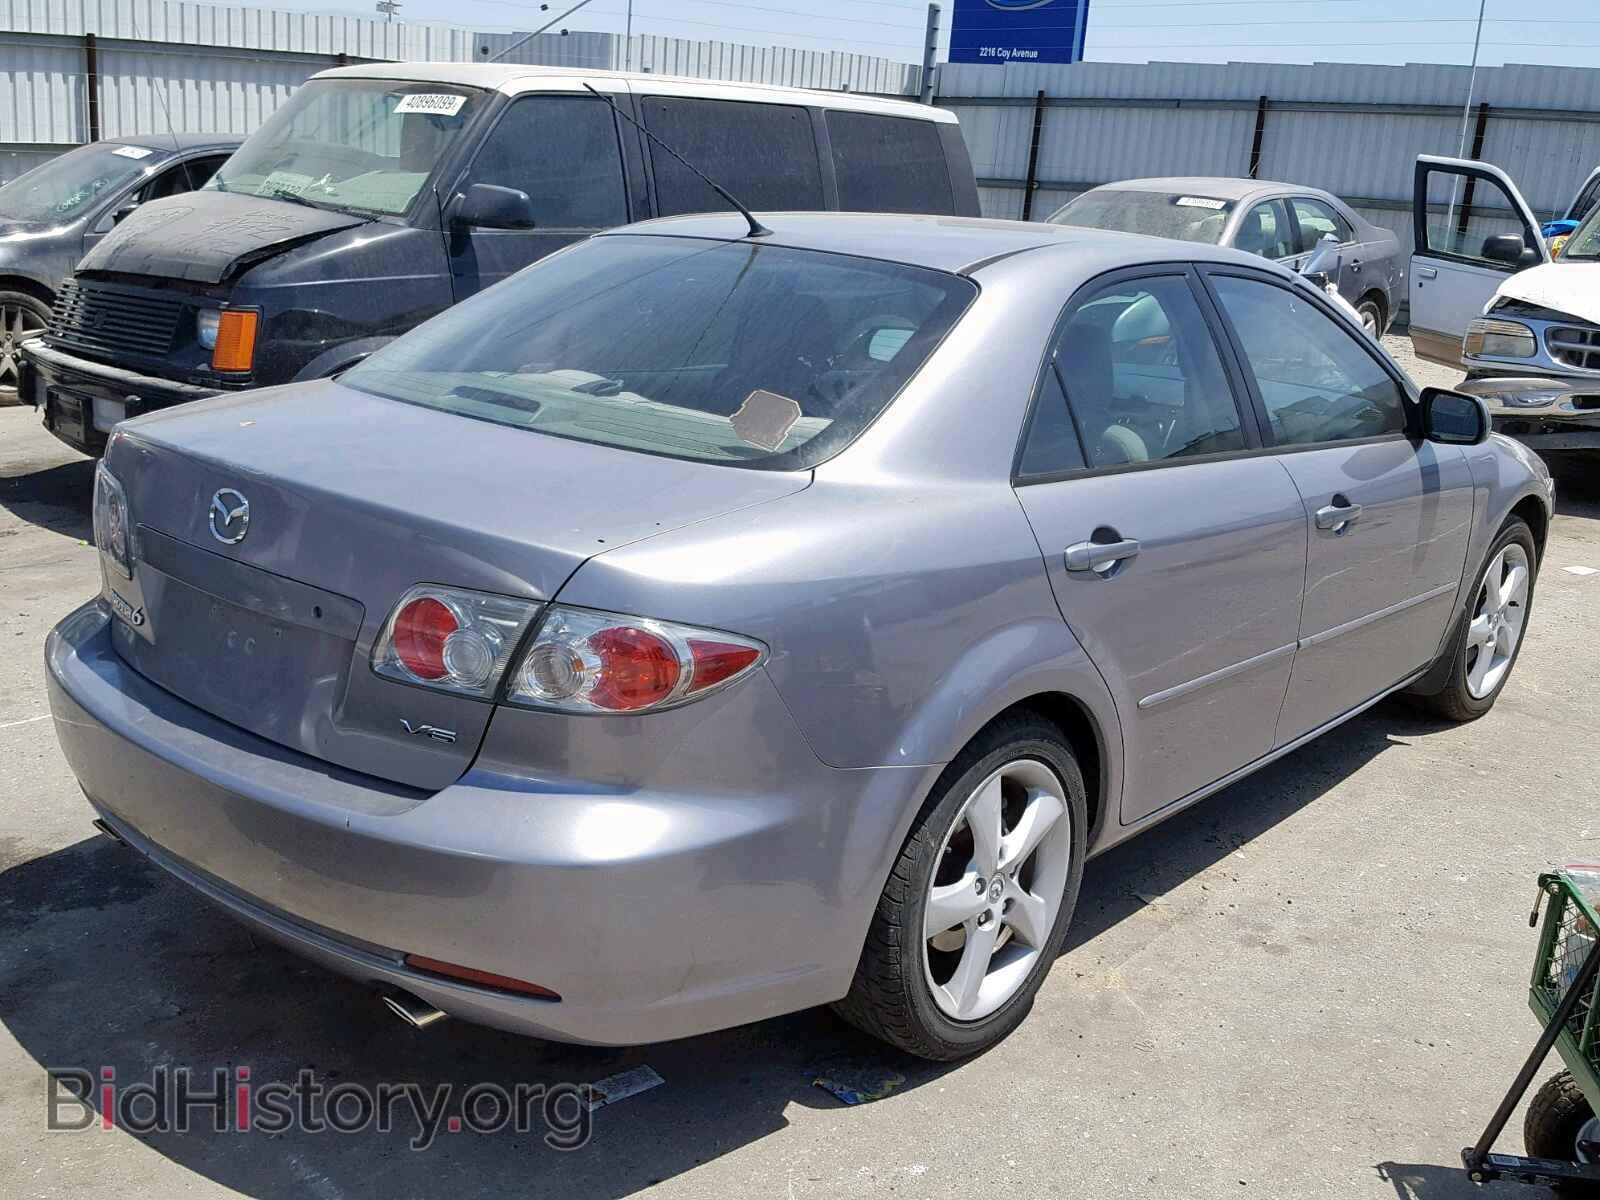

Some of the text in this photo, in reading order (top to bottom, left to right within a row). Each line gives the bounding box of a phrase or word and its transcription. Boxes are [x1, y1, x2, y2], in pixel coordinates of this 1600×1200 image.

[979, 47, 1038, 60] 2216 Coy Avenue
